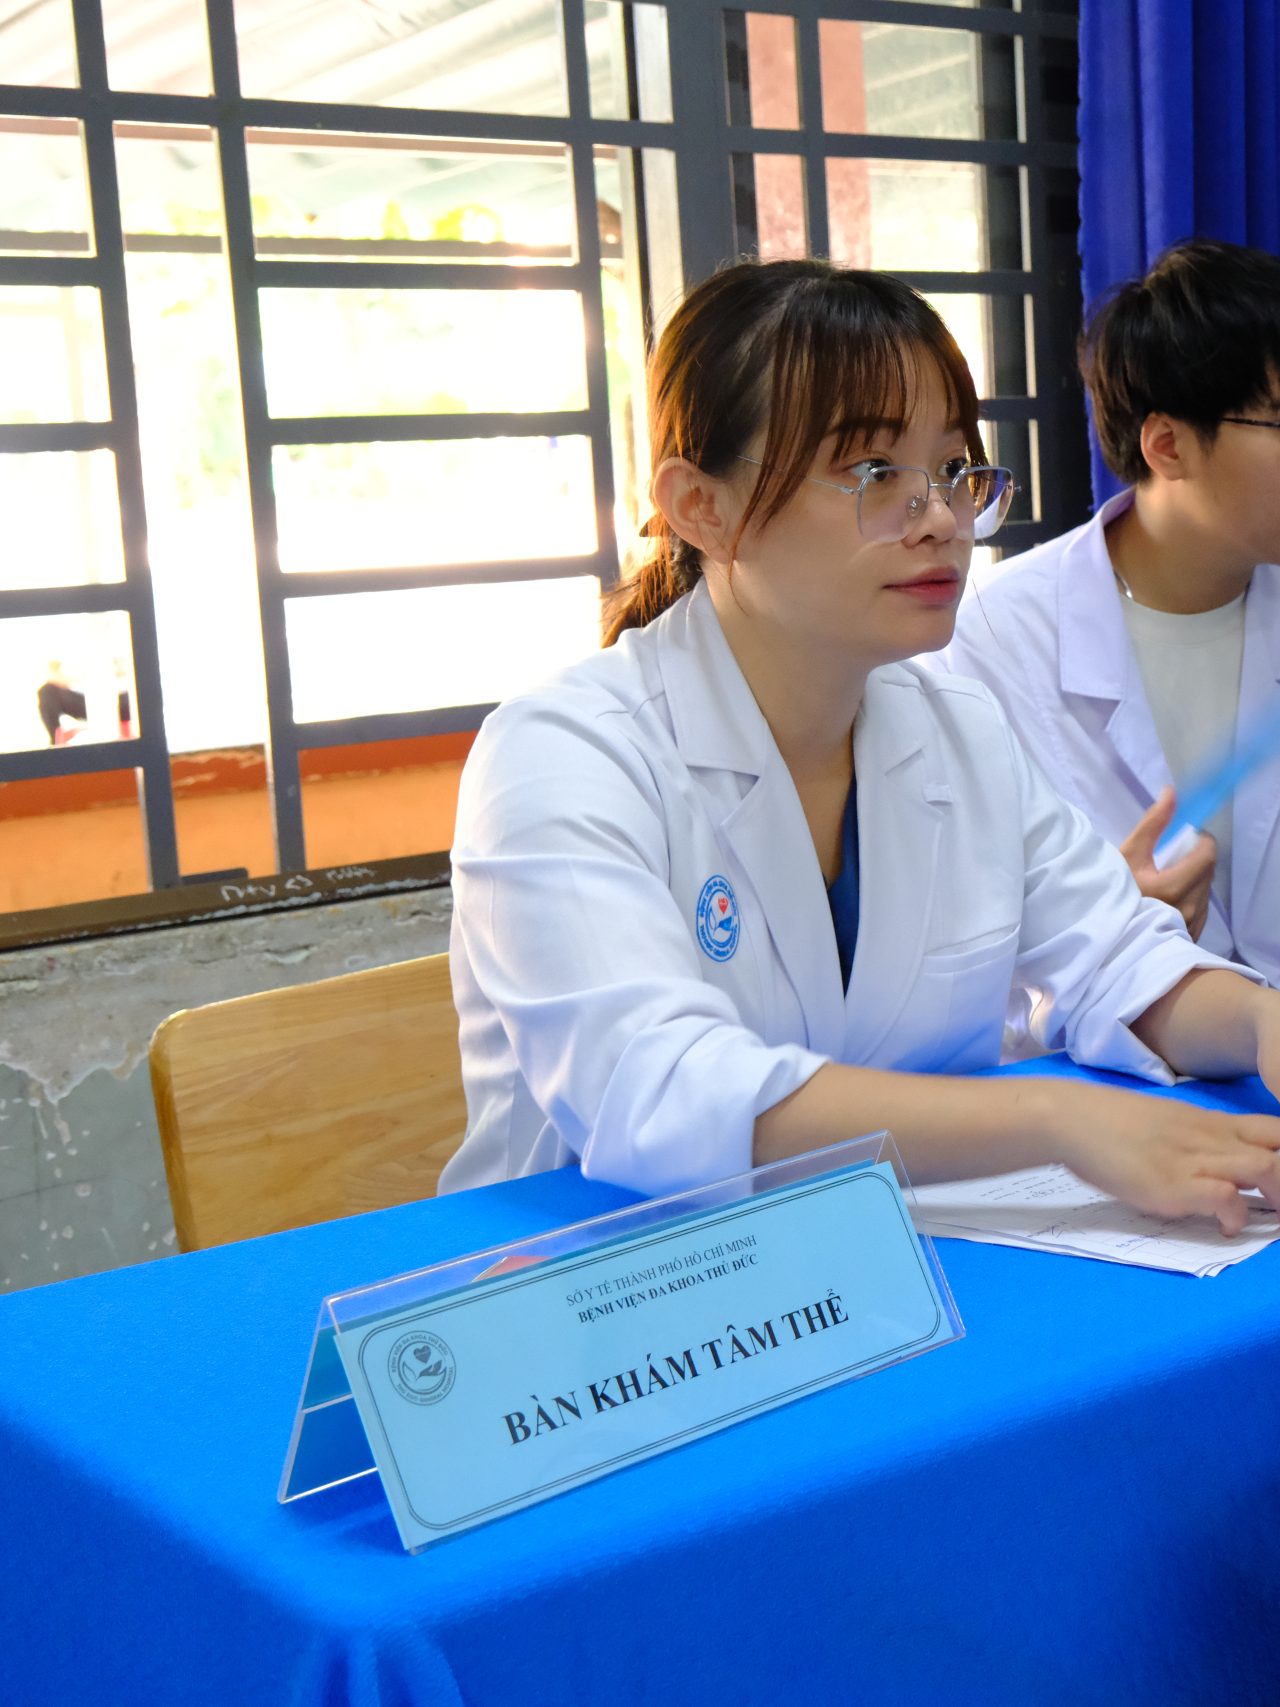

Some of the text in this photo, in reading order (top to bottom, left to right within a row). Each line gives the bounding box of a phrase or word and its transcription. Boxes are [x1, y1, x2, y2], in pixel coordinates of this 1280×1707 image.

[578, 1253, 759, 1324] BỆNH VIỆN ĐA KHOA THỦ ĐỨC
[584, 1287, 594, 1300] Y
[613, 1267, 658, 1291] THÀNH
[658, 1258, 683, 1276] PHỐ
[684, 1251, 702, 1269] HỒ
[726, 1235, 758, 1255] MINH
[501, 1288, 849, 1445] BÀN KHÁM TÂM THỂ
